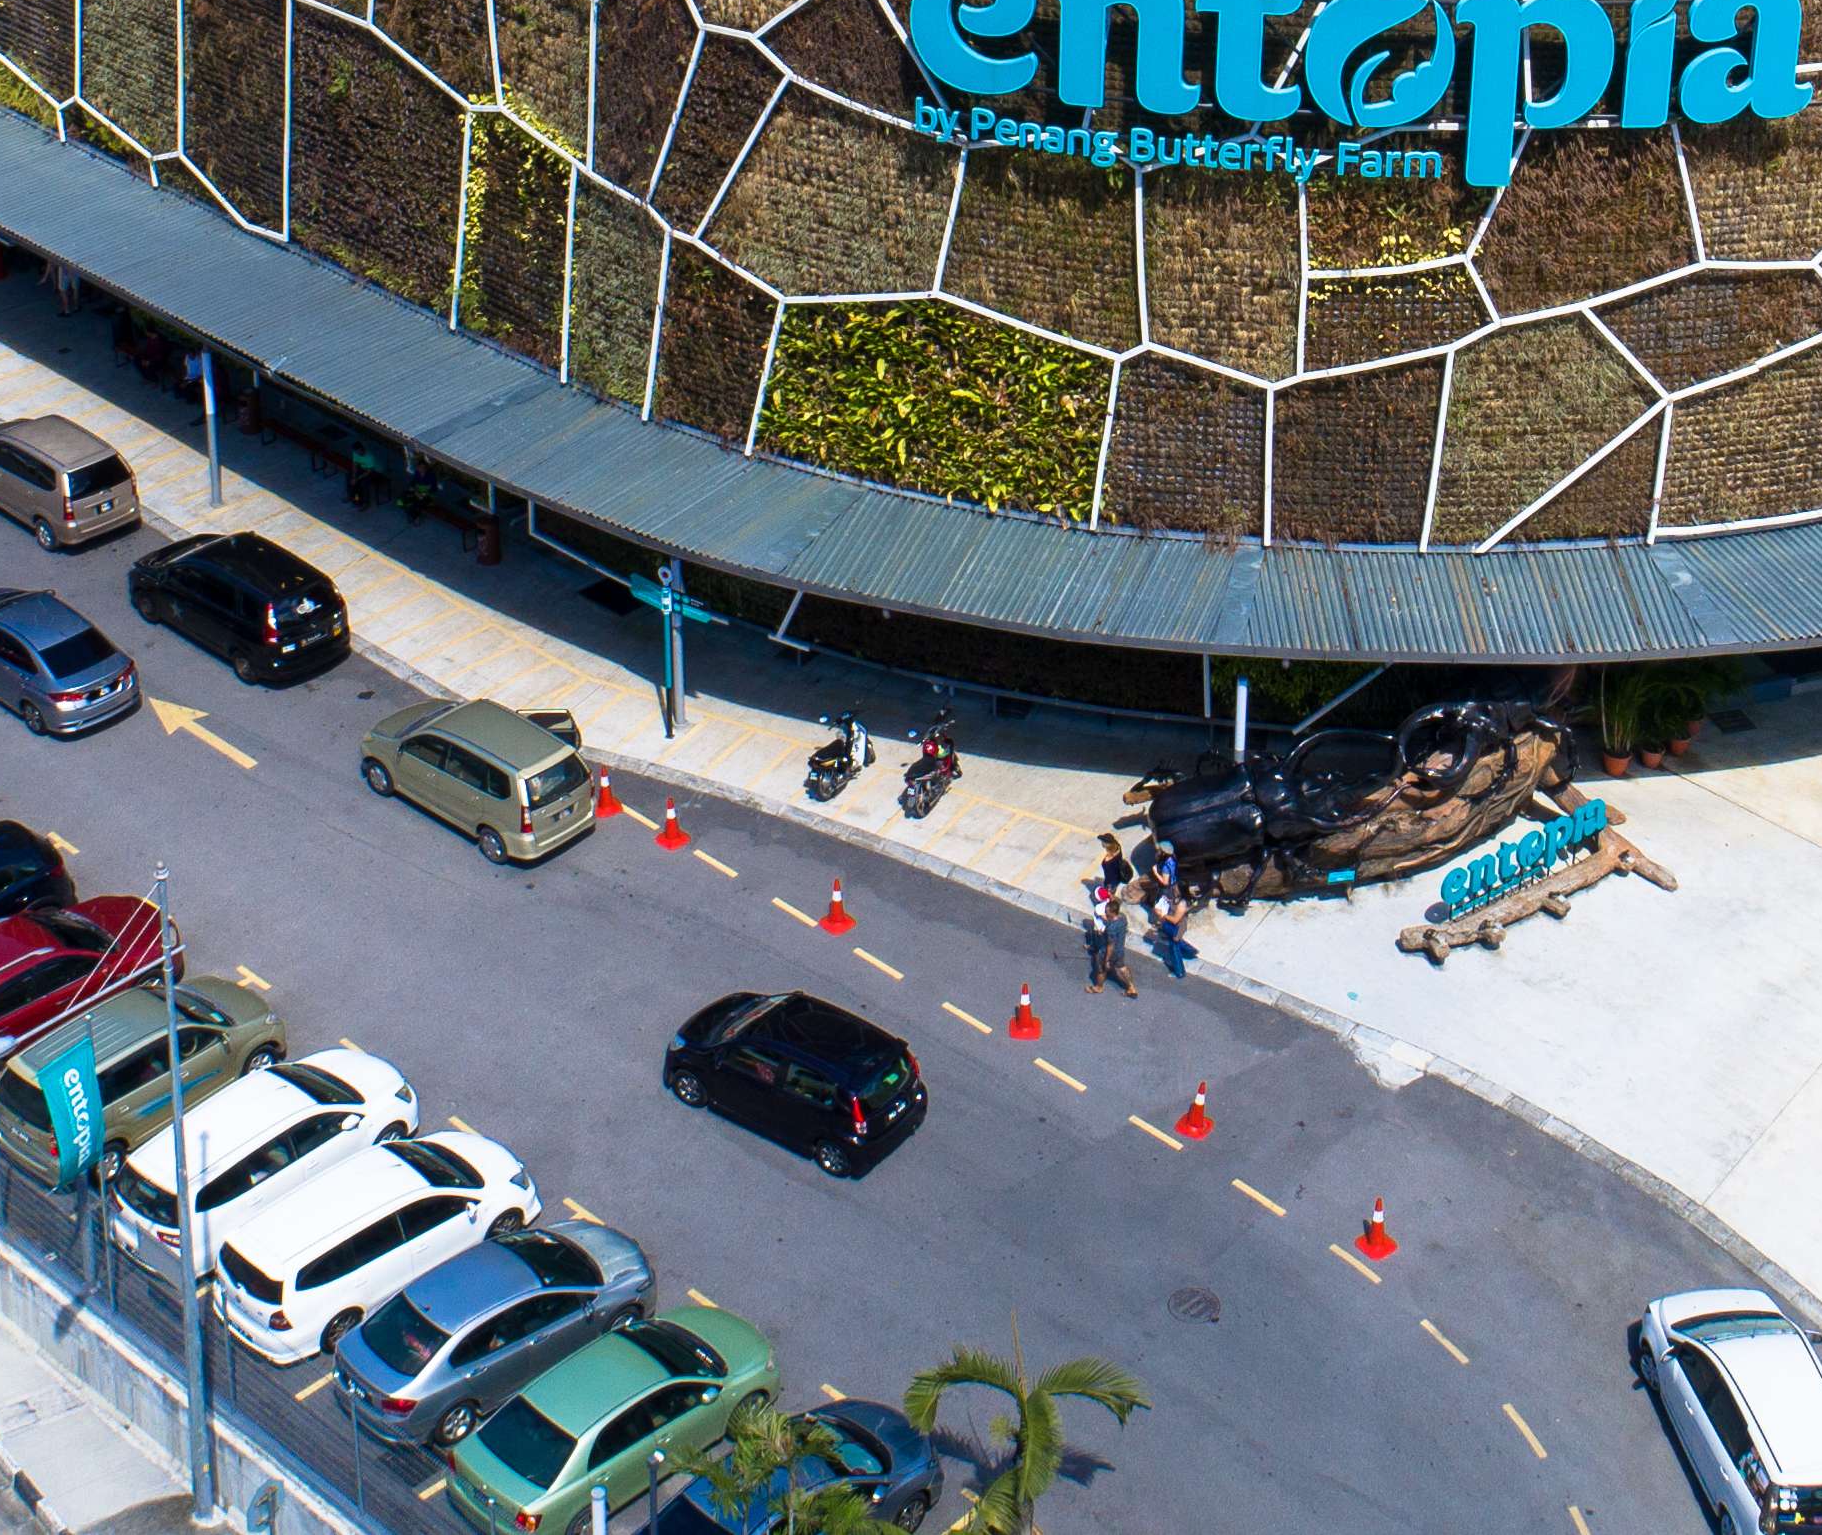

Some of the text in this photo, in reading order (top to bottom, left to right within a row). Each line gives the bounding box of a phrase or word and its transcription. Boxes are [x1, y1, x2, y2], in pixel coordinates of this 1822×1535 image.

[915, 96, 1443, 182] by Penang Butterfly Farm
[1441, 798, 1608, 905] entopia
